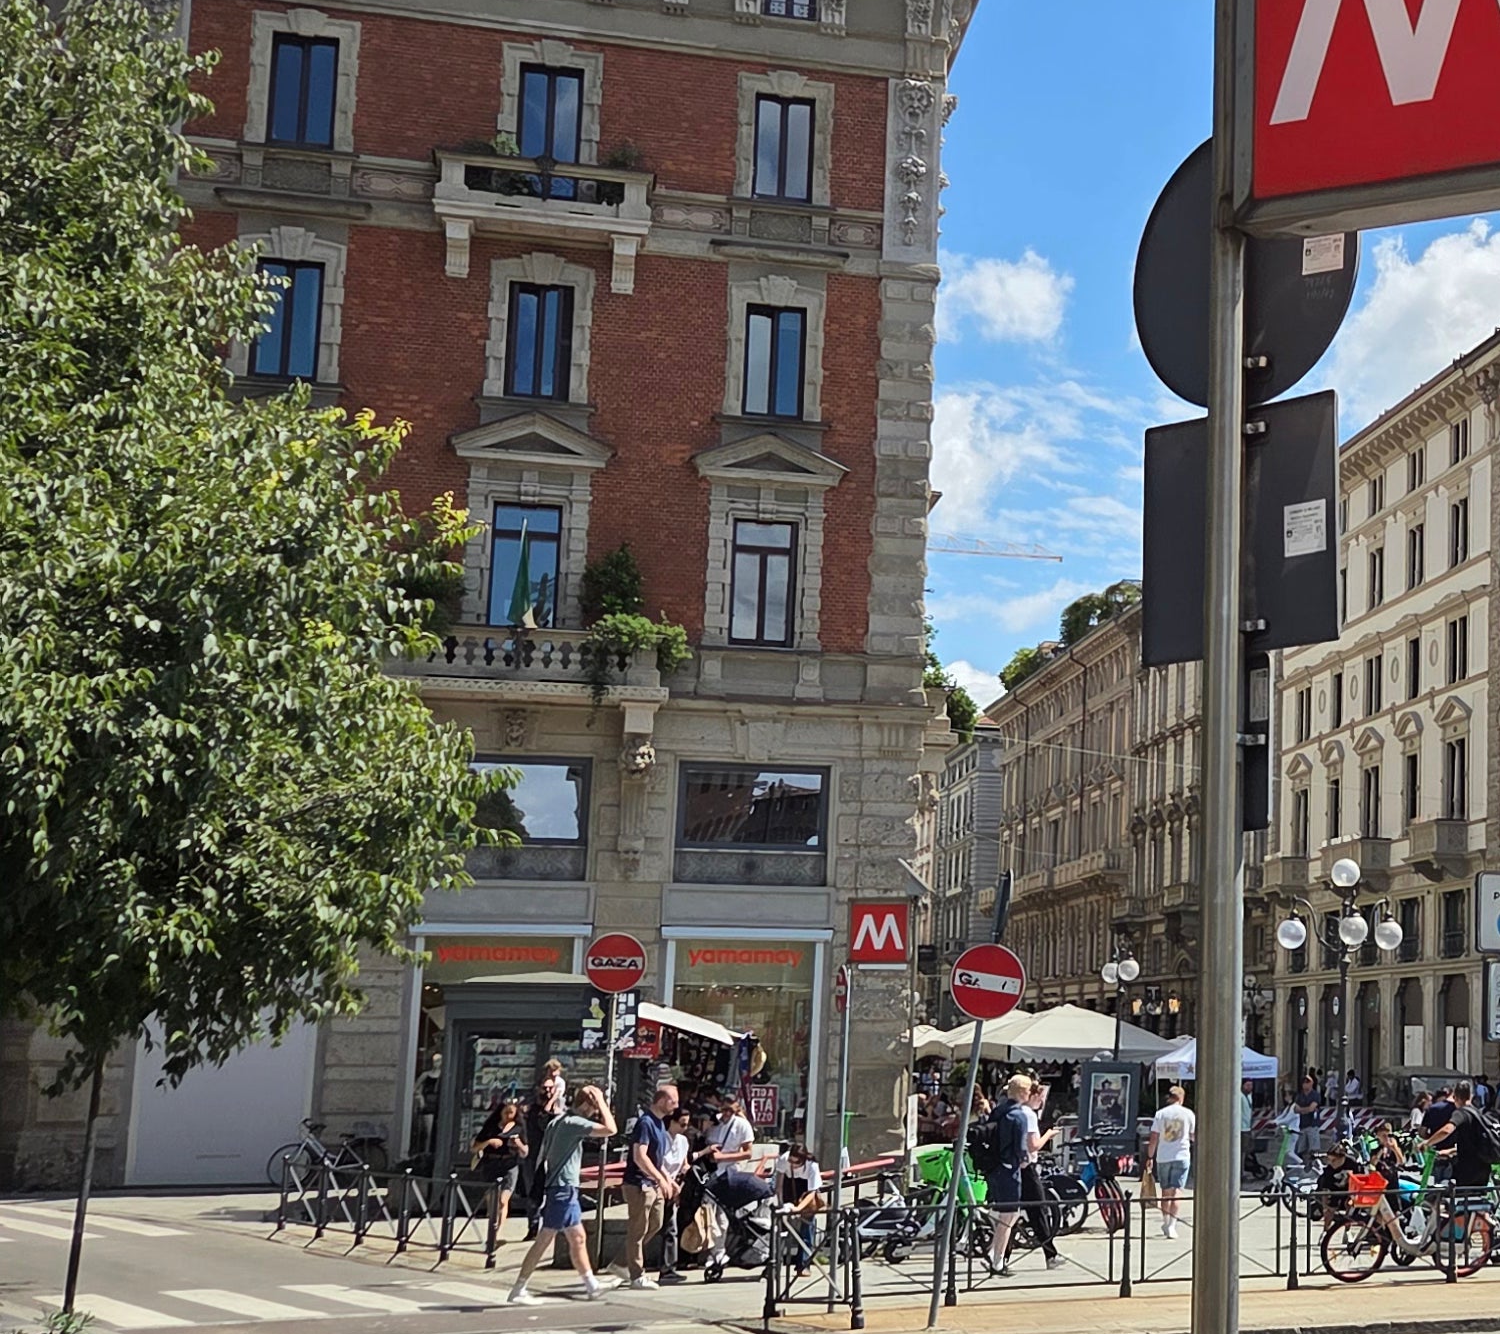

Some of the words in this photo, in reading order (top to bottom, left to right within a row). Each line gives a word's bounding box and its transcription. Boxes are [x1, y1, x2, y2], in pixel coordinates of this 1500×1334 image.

[853, 913, 904, 950] M
[437, 945, 559, 965] yamamay
[590, 956, 639, 970] GAZA
[689, 946, 803, 967] yamamay
